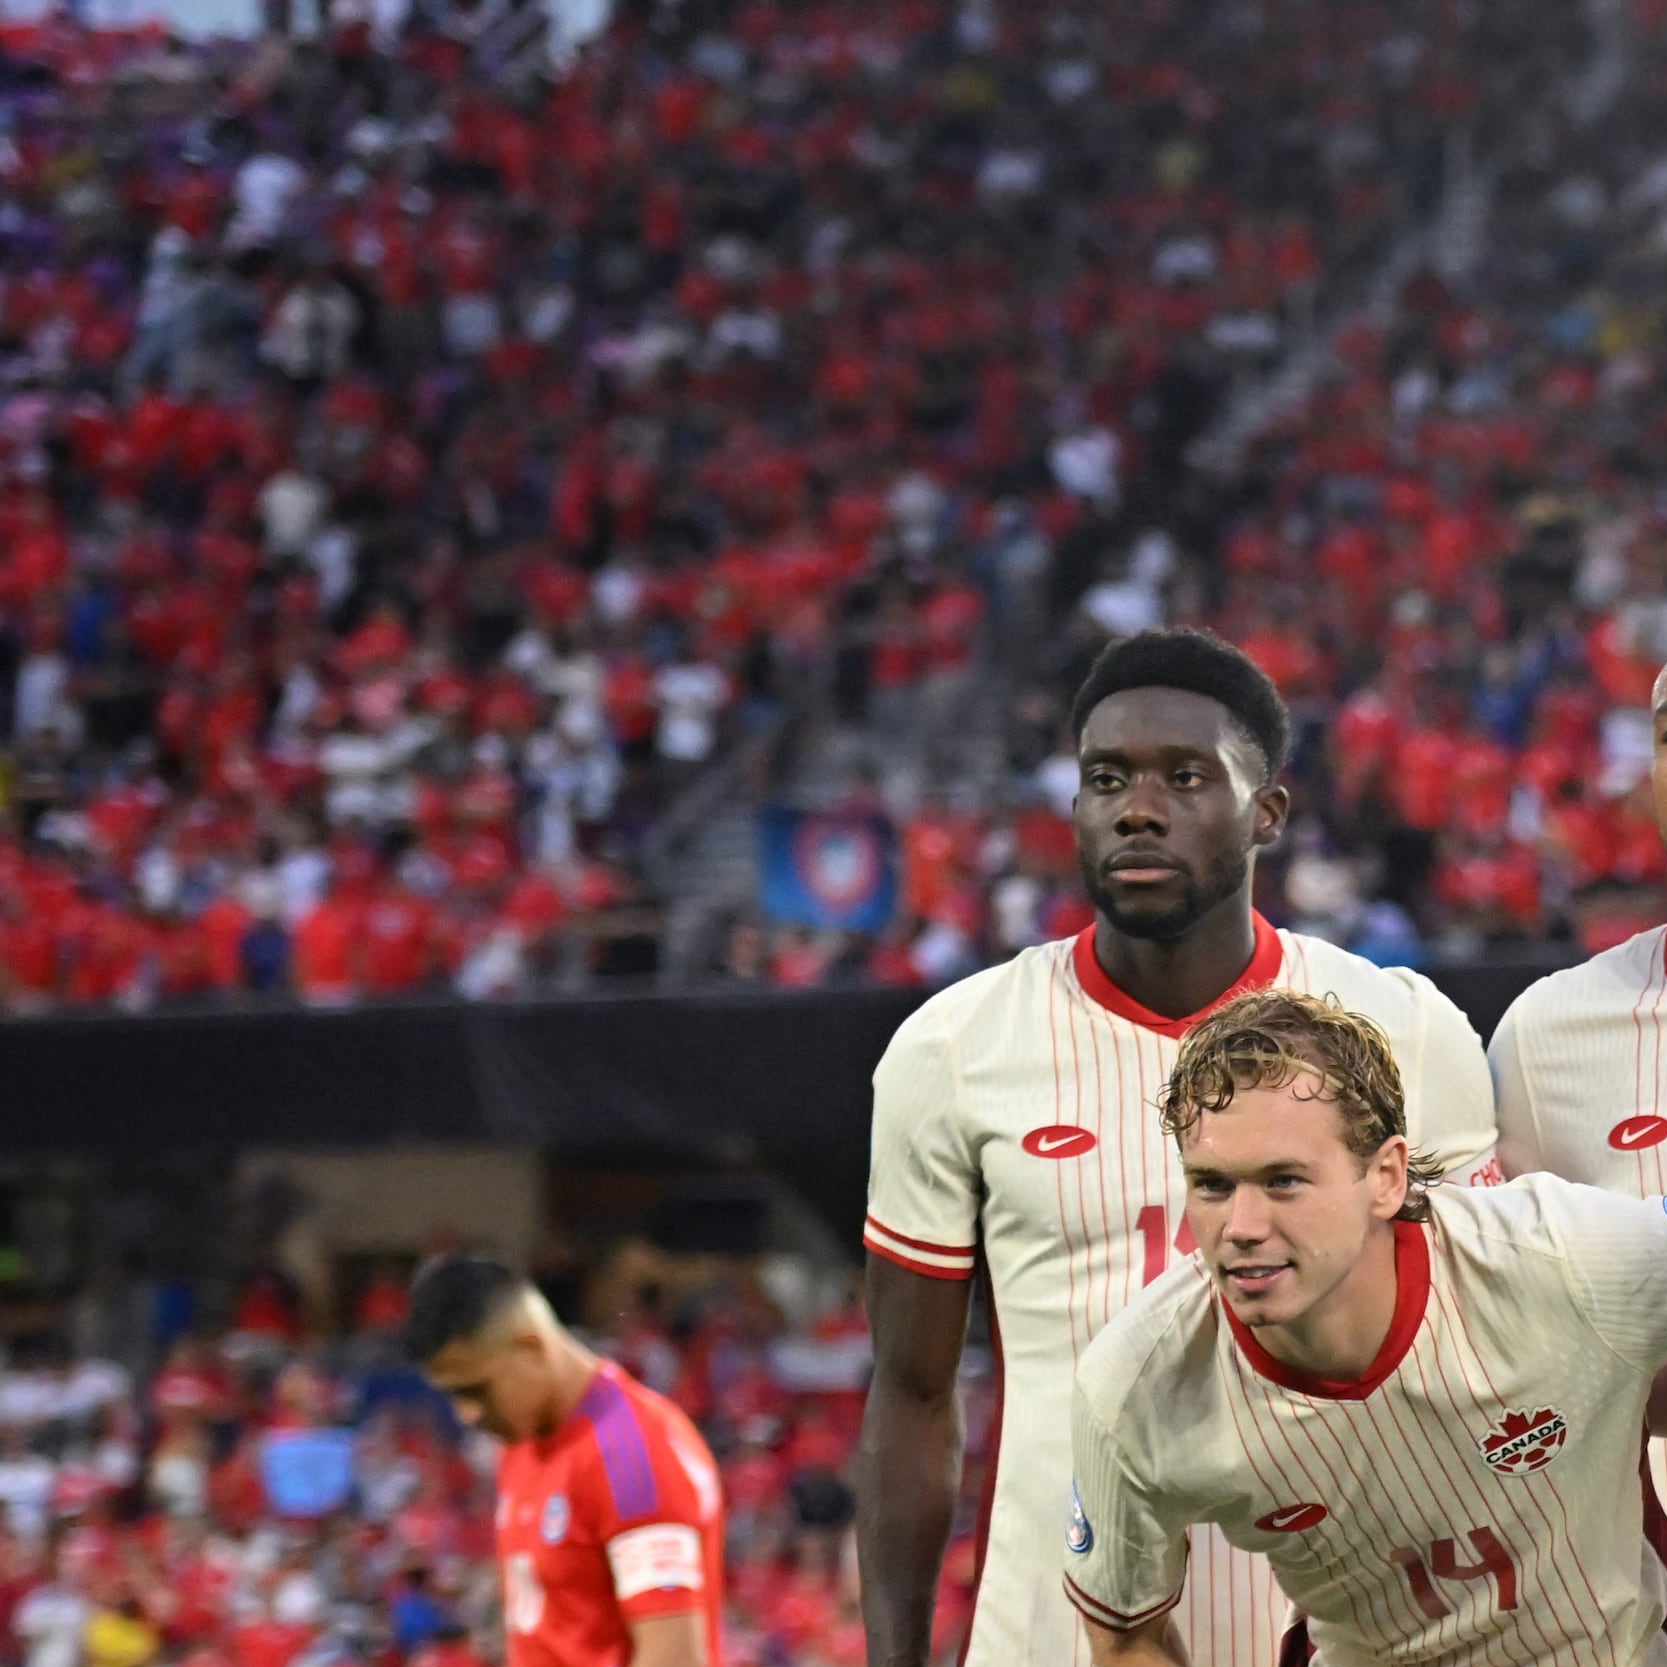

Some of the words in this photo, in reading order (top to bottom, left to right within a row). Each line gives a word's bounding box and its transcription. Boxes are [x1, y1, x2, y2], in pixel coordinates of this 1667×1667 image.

[1135, 1205, 1200, 1288] 1
[1486, 1420, 1566, 1464] CANADA
[1390, 1526, 1518, 1619] 14
